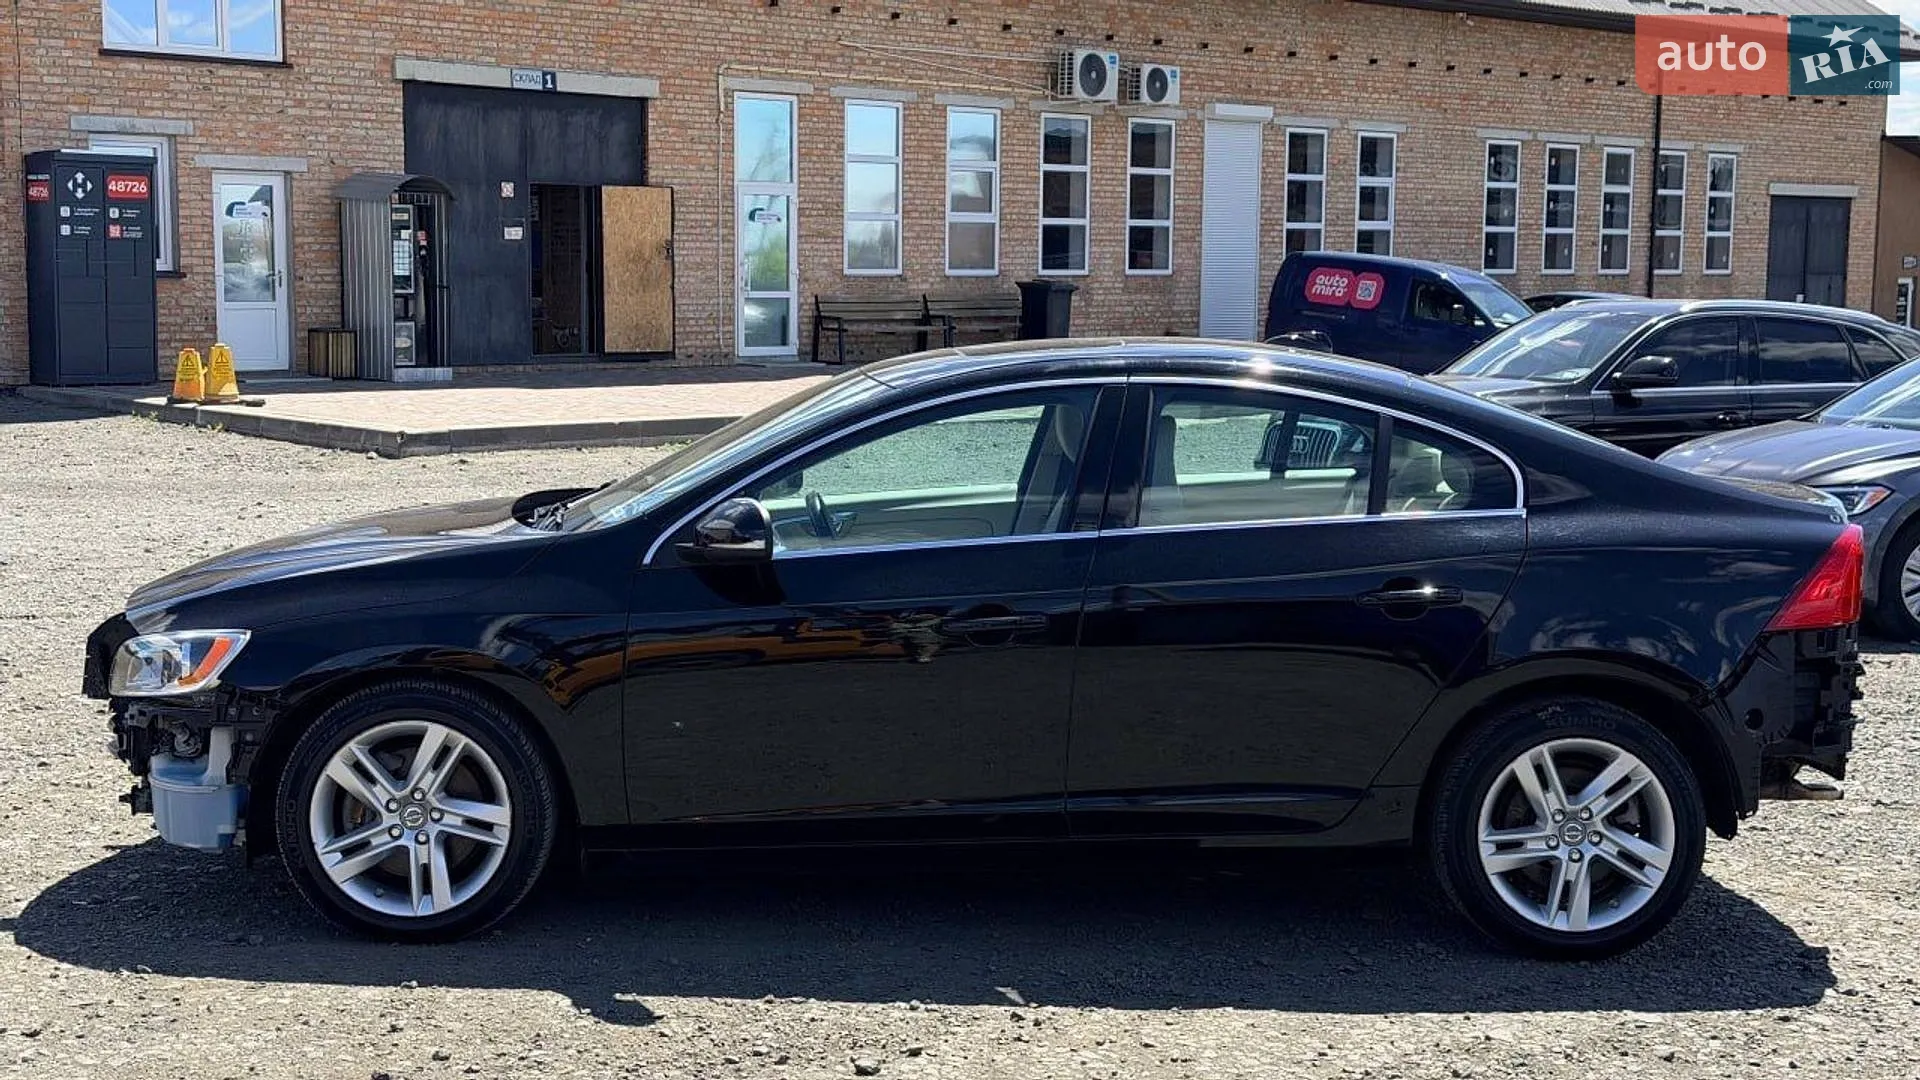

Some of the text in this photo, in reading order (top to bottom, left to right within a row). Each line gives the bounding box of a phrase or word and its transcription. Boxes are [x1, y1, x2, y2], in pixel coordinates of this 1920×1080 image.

[545, 74, 553, 88] 1
[108, 180, 148, 193] 48726
[1315, 274, 1349, 287] auto
